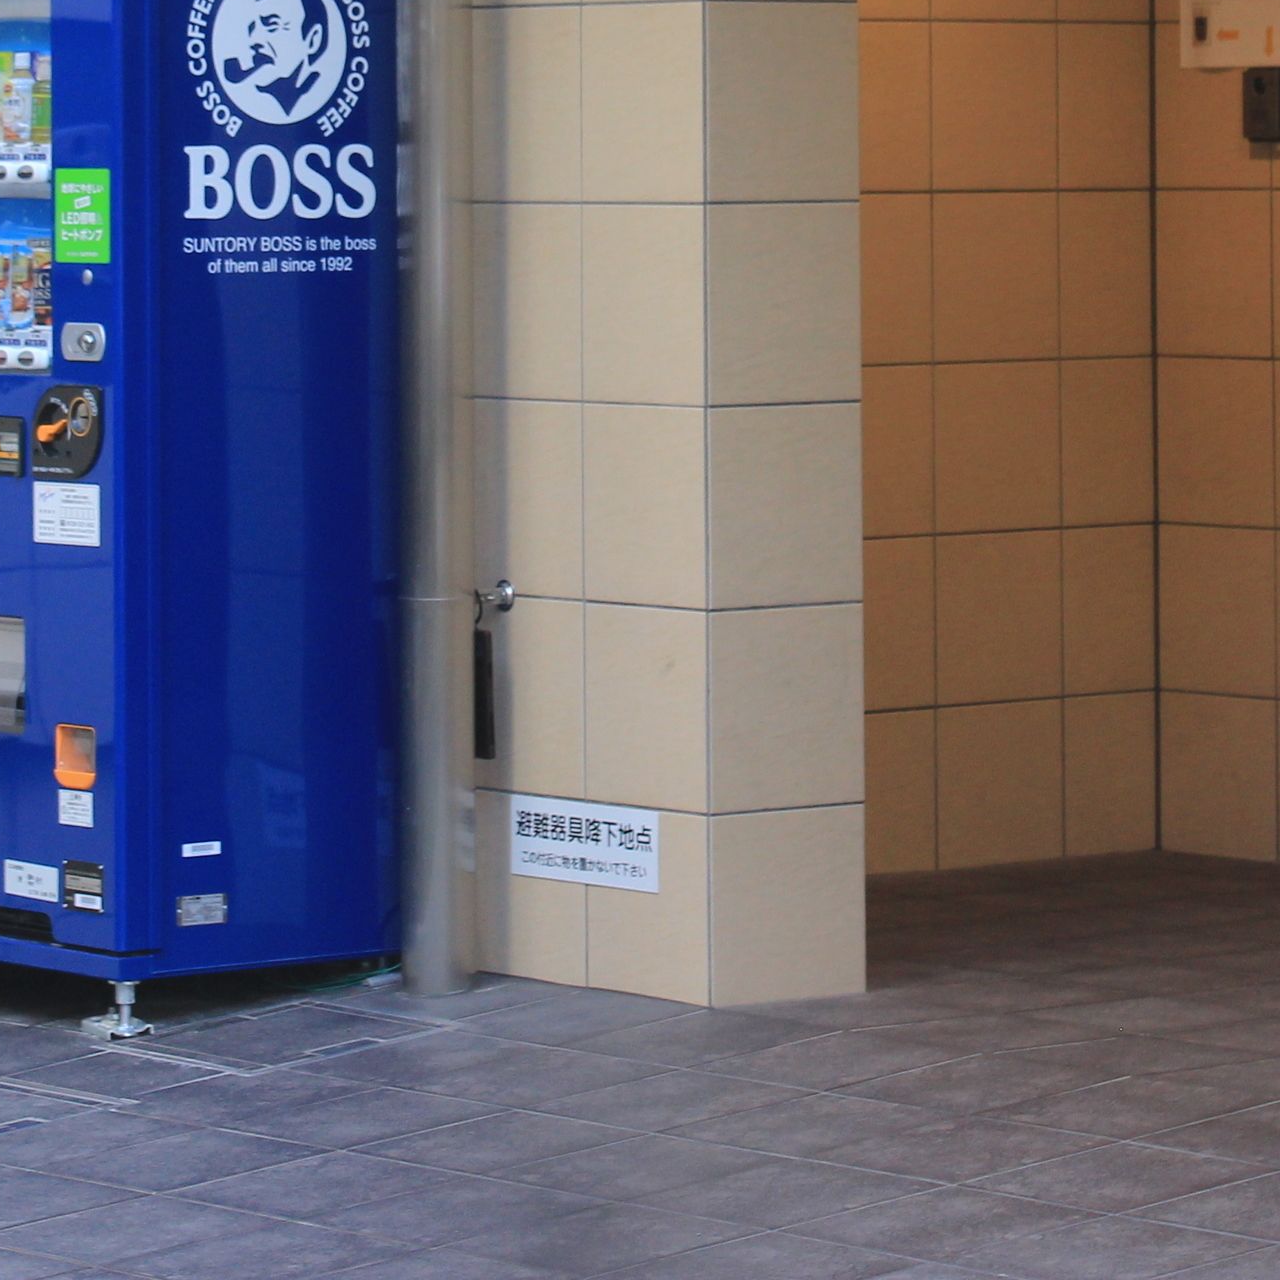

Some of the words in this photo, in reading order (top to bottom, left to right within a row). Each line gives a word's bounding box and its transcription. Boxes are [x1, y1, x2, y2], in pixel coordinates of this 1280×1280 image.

[195, 80, 244, 138] BOSS
[316, 56, 370, 138] COFFEE
[182, 142, 377, 220] BOSS
[182, 237, 257, 253] SUNTORY
[261, 236, 302, 252] BOSS
[306, 236, 317, 251] is
[320, 236, 341, 251] the
[345, 235, 377, 251] boss
[207, 259, 223, 273] of
[225, 258, 258, 273] them
[262, 258, 278, 272] all
[281, 257, 316, 272] since
[320, 257, 353, 271] 1992
[515, 809, 653, 853] 避難器具降下地点
